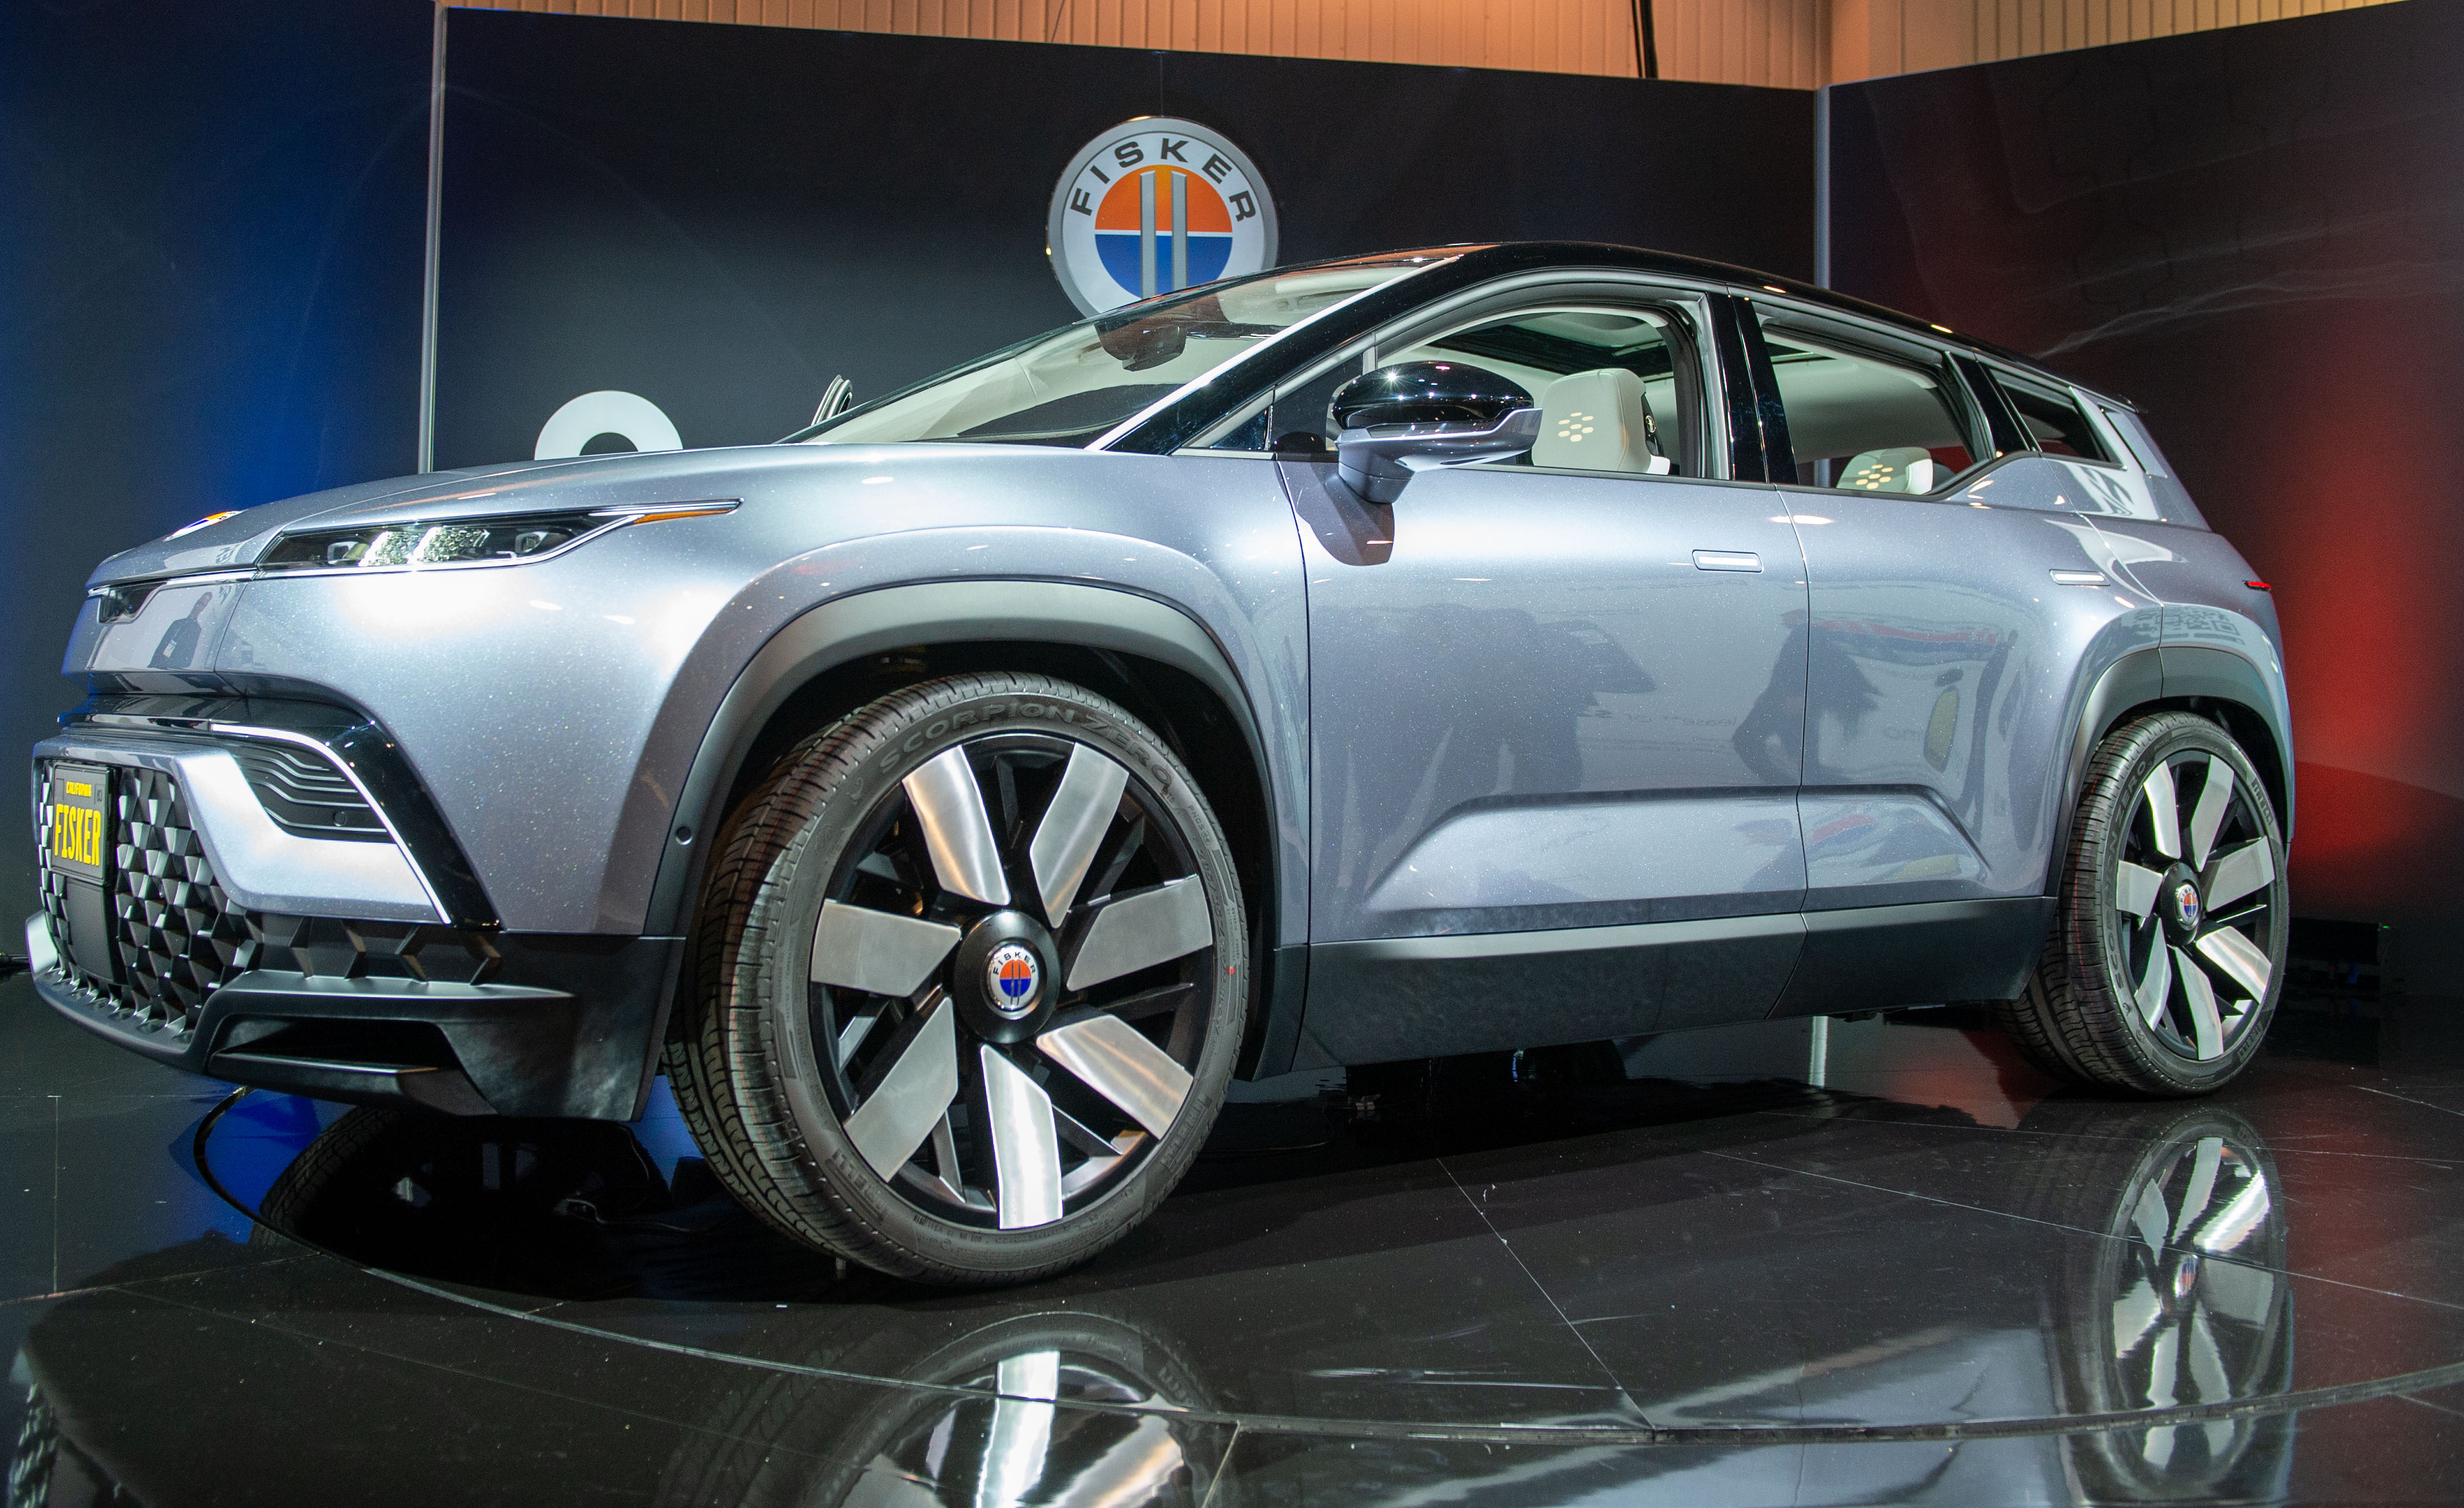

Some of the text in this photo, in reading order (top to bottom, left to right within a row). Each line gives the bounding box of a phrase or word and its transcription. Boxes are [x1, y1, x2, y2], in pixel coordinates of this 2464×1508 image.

[1071, 138, 1256, 221] FISKER
[880, 703, 1172, 785] SCORPION ZERO
[2115, 760, 2146, 827] ZERO
[54, 804, 101, 867] FISKER
[993, 952, 1036, 975] FISKER
